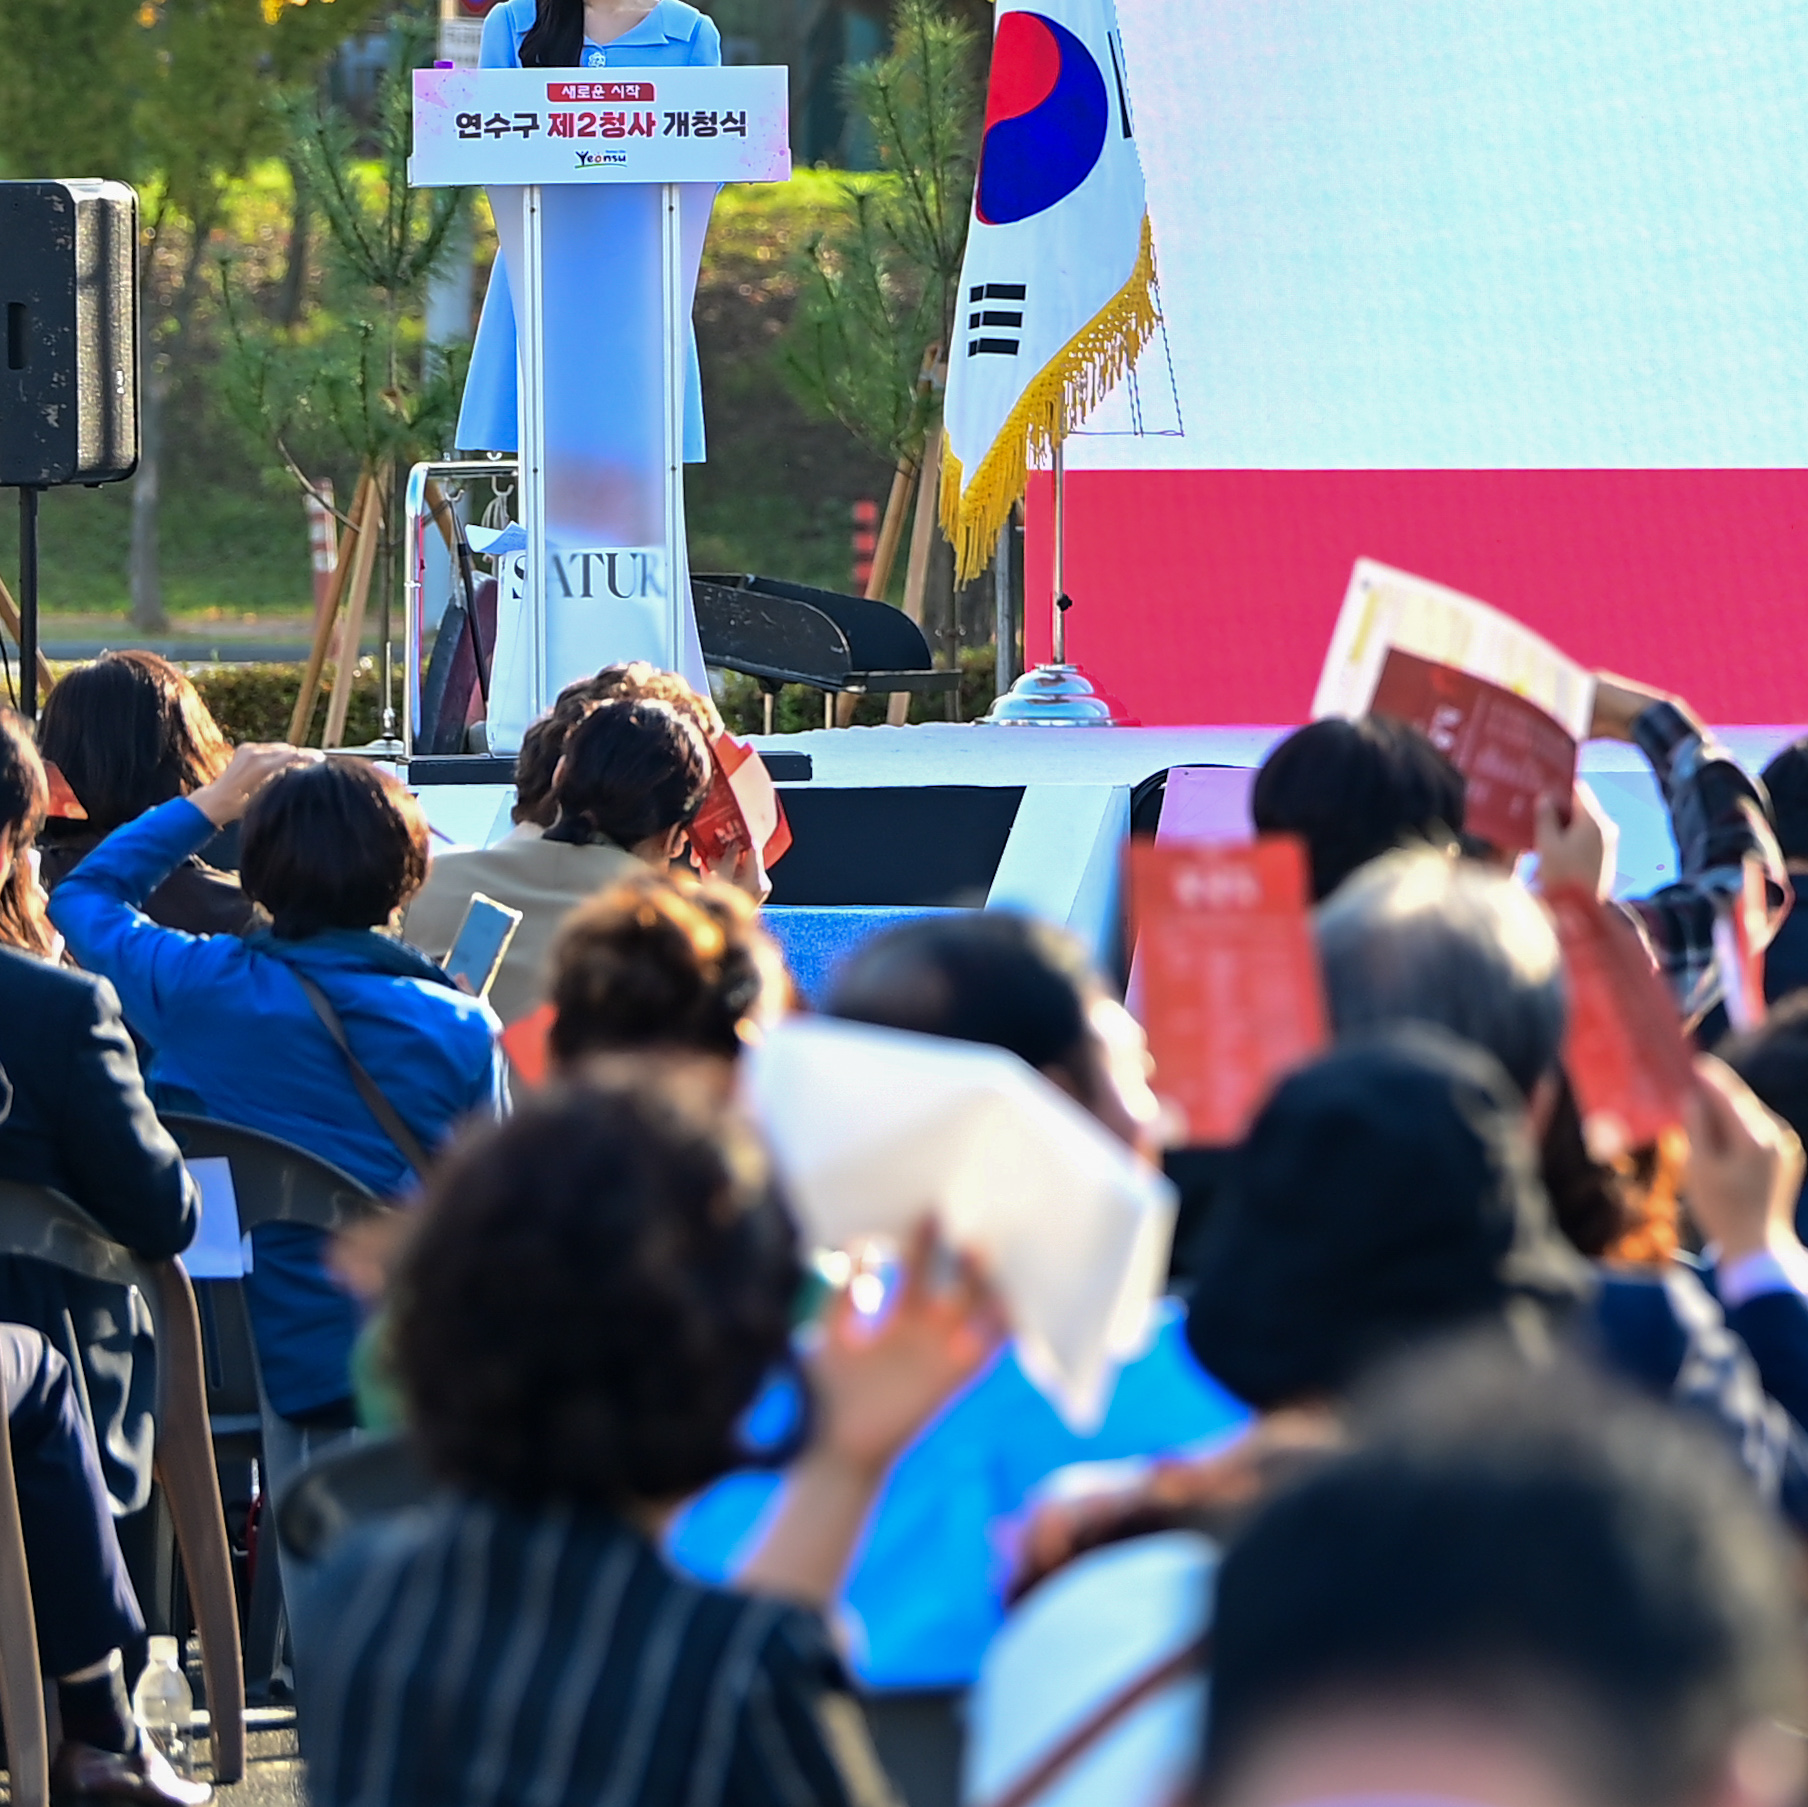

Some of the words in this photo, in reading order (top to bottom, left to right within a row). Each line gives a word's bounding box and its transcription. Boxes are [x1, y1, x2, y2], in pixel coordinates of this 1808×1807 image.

[561, 84, 605, 99] 새로운
[610, 84, 641, 99] 시작
[456, 112, 540, 138] 연수구
[547, 112, 656, 138] 제2청사
[662, 111, 747, 137] 개청식
[575, 150, 626, 166] Yeonsu
